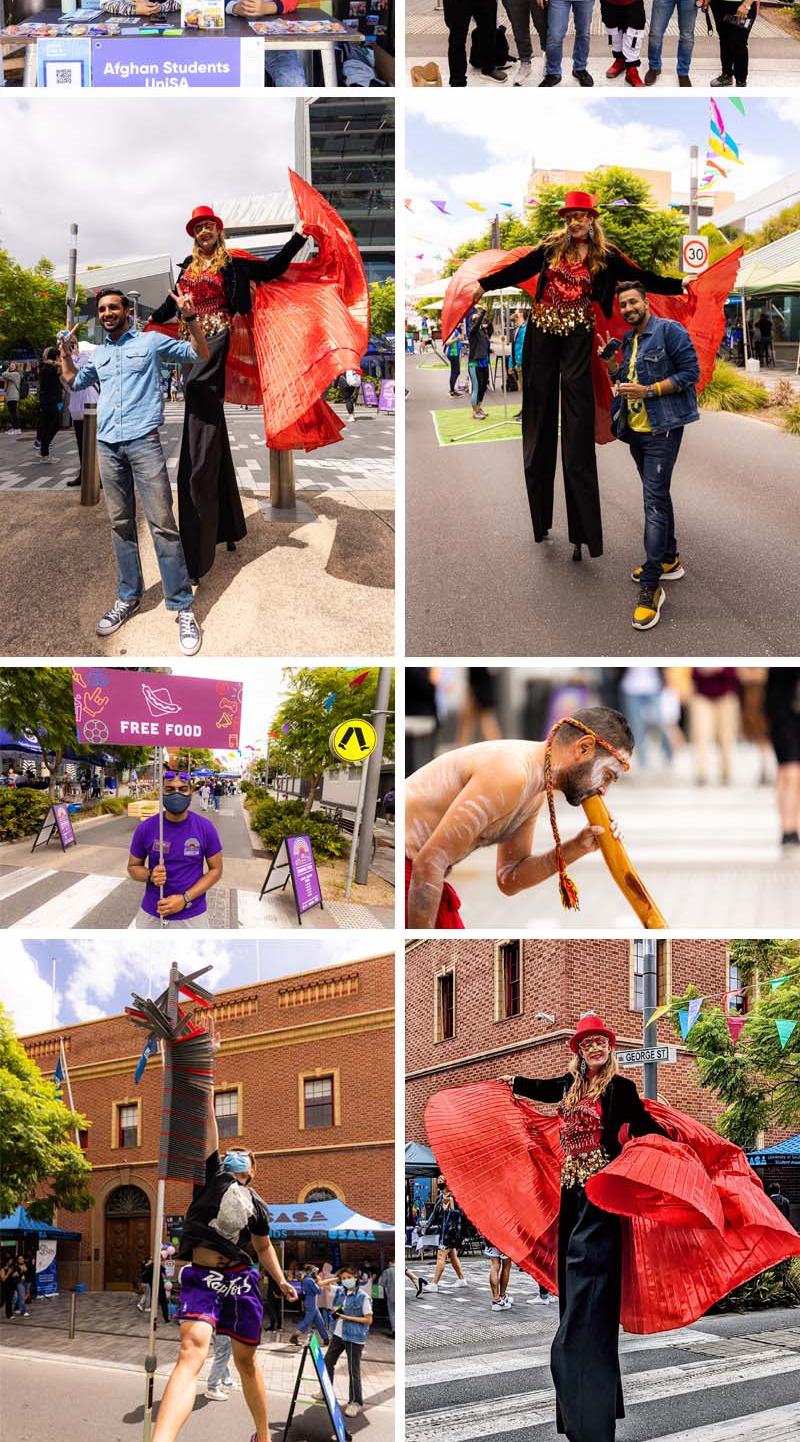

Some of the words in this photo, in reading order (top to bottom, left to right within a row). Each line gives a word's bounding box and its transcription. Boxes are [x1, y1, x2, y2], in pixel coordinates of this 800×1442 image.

[103, 62, 159, 78] Afghan
[163, 61, 230, 74] Students
[145, 77, 189, 87] UniSA
[689, 248, 704, 260] 30
[120, 720, 159, 735] FREE
[165, 723, 201, 737] FOOD
[625, 1050, 655, 1062] GEORGE
[656, 1049, 666, 1059] ST
[327, 1229, 376, 1240] USASA
[202, 1270, 252, 1297] Raptors
